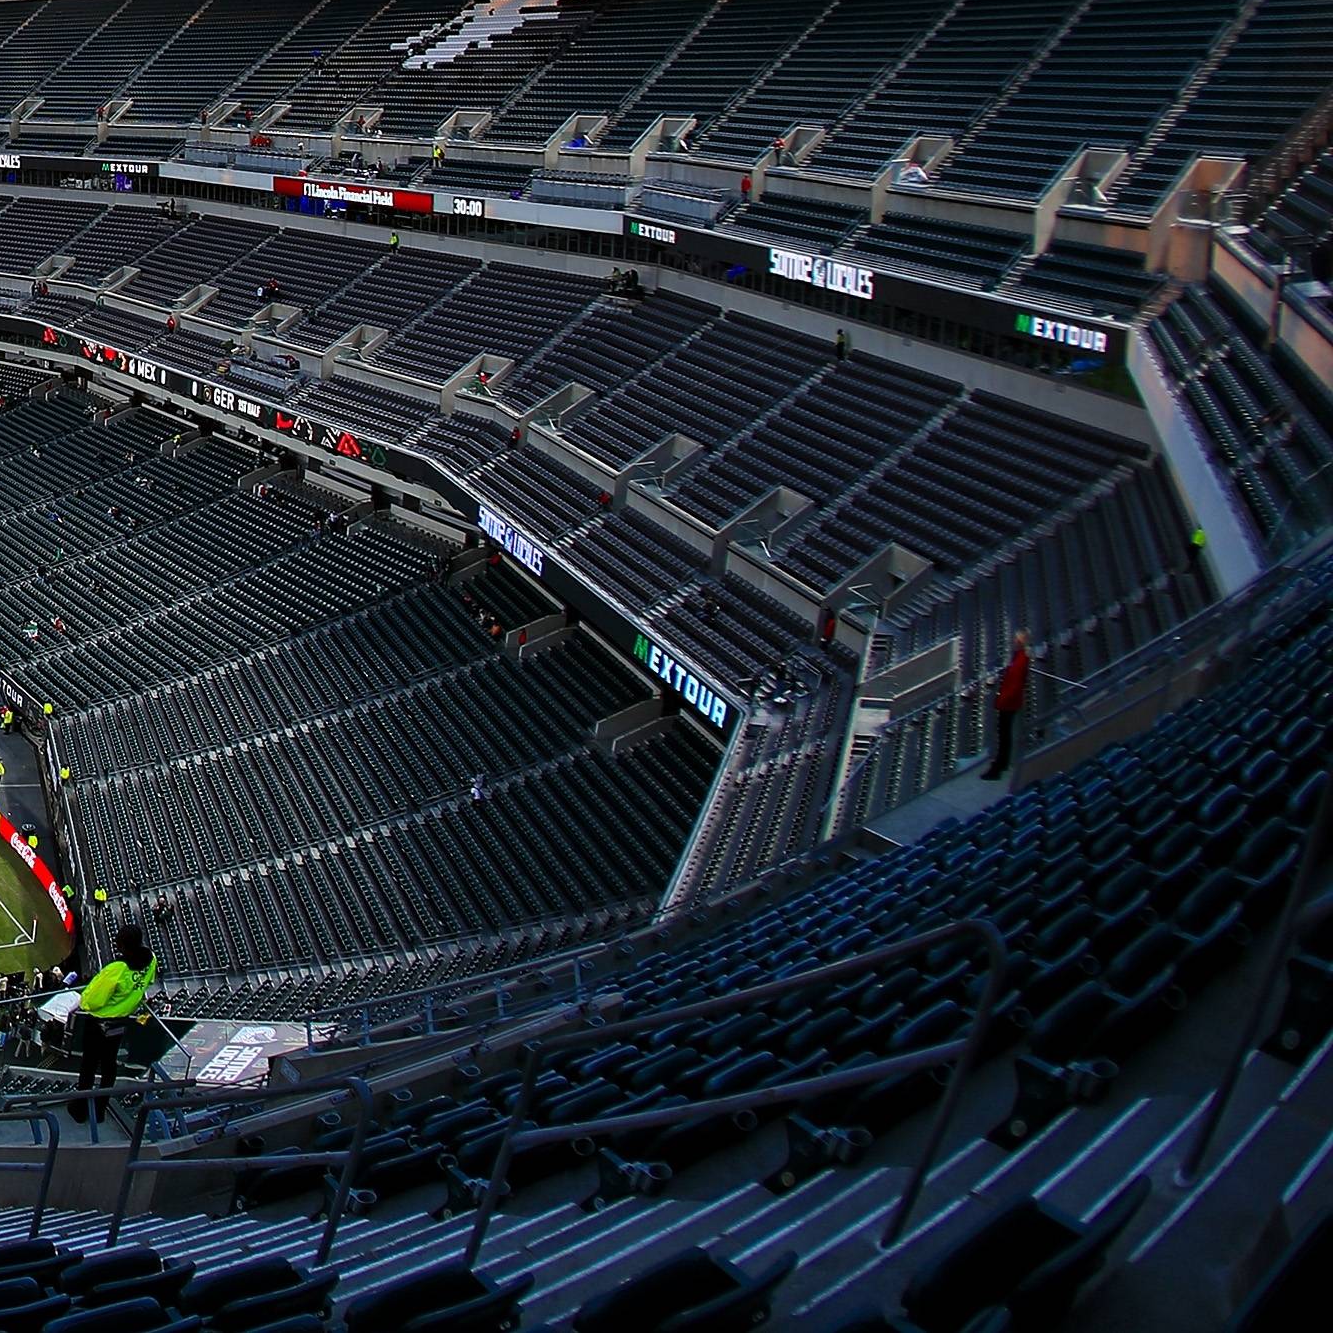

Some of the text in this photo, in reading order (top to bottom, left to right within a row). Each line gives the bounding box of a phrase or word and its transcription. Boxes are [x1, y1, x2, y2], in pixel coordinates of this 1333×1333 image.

[102, 163, 149, 174] MEXTOUR
[311, 184, 394, 207] Lincoln Financial Field
[453, 198, 482, 216] 30:00
[630, 222, 676, 244] MEXTOUR
[1015, 314, 1107, 353] MEXTOUR
[137, 361, 157, 382] MEX
[214, 387, 234, 411] GER
[634, 634, 727, 729] MEXTOUR
